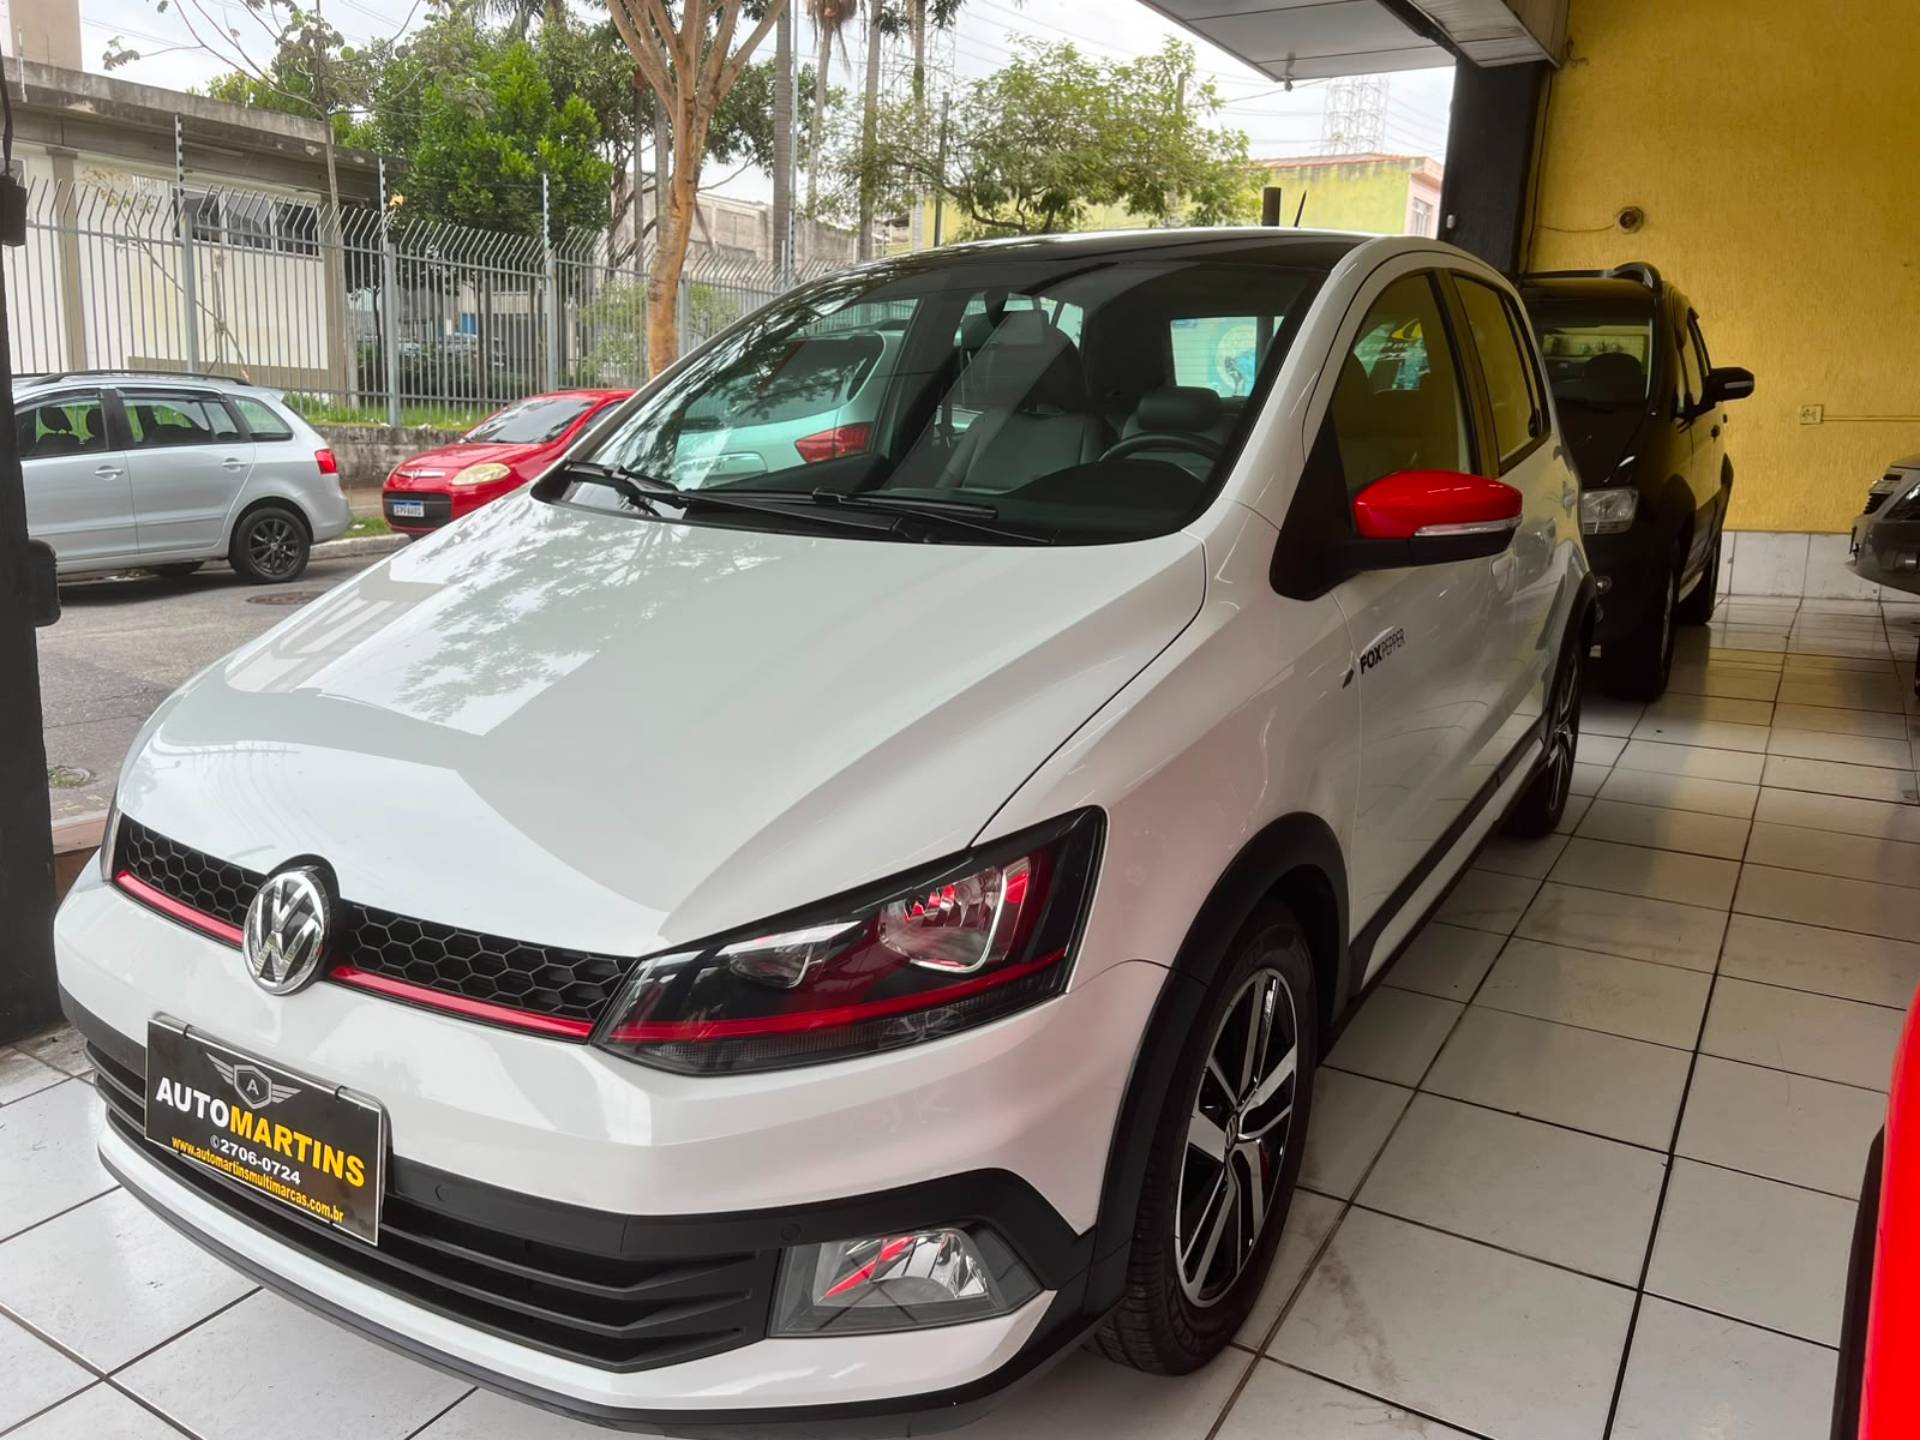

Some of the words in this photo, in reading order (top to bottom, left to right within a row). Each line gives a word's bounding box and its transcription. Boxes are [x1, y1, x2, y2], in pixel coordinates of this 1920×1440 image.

[246, 870, 324, 992] VW
[245, 1078, 260, 1097] A
[171, 1136, 344, 1223] www.automartinsmultimarcas.com.br
[219, 1138, 301, 1185] 2706-0724
